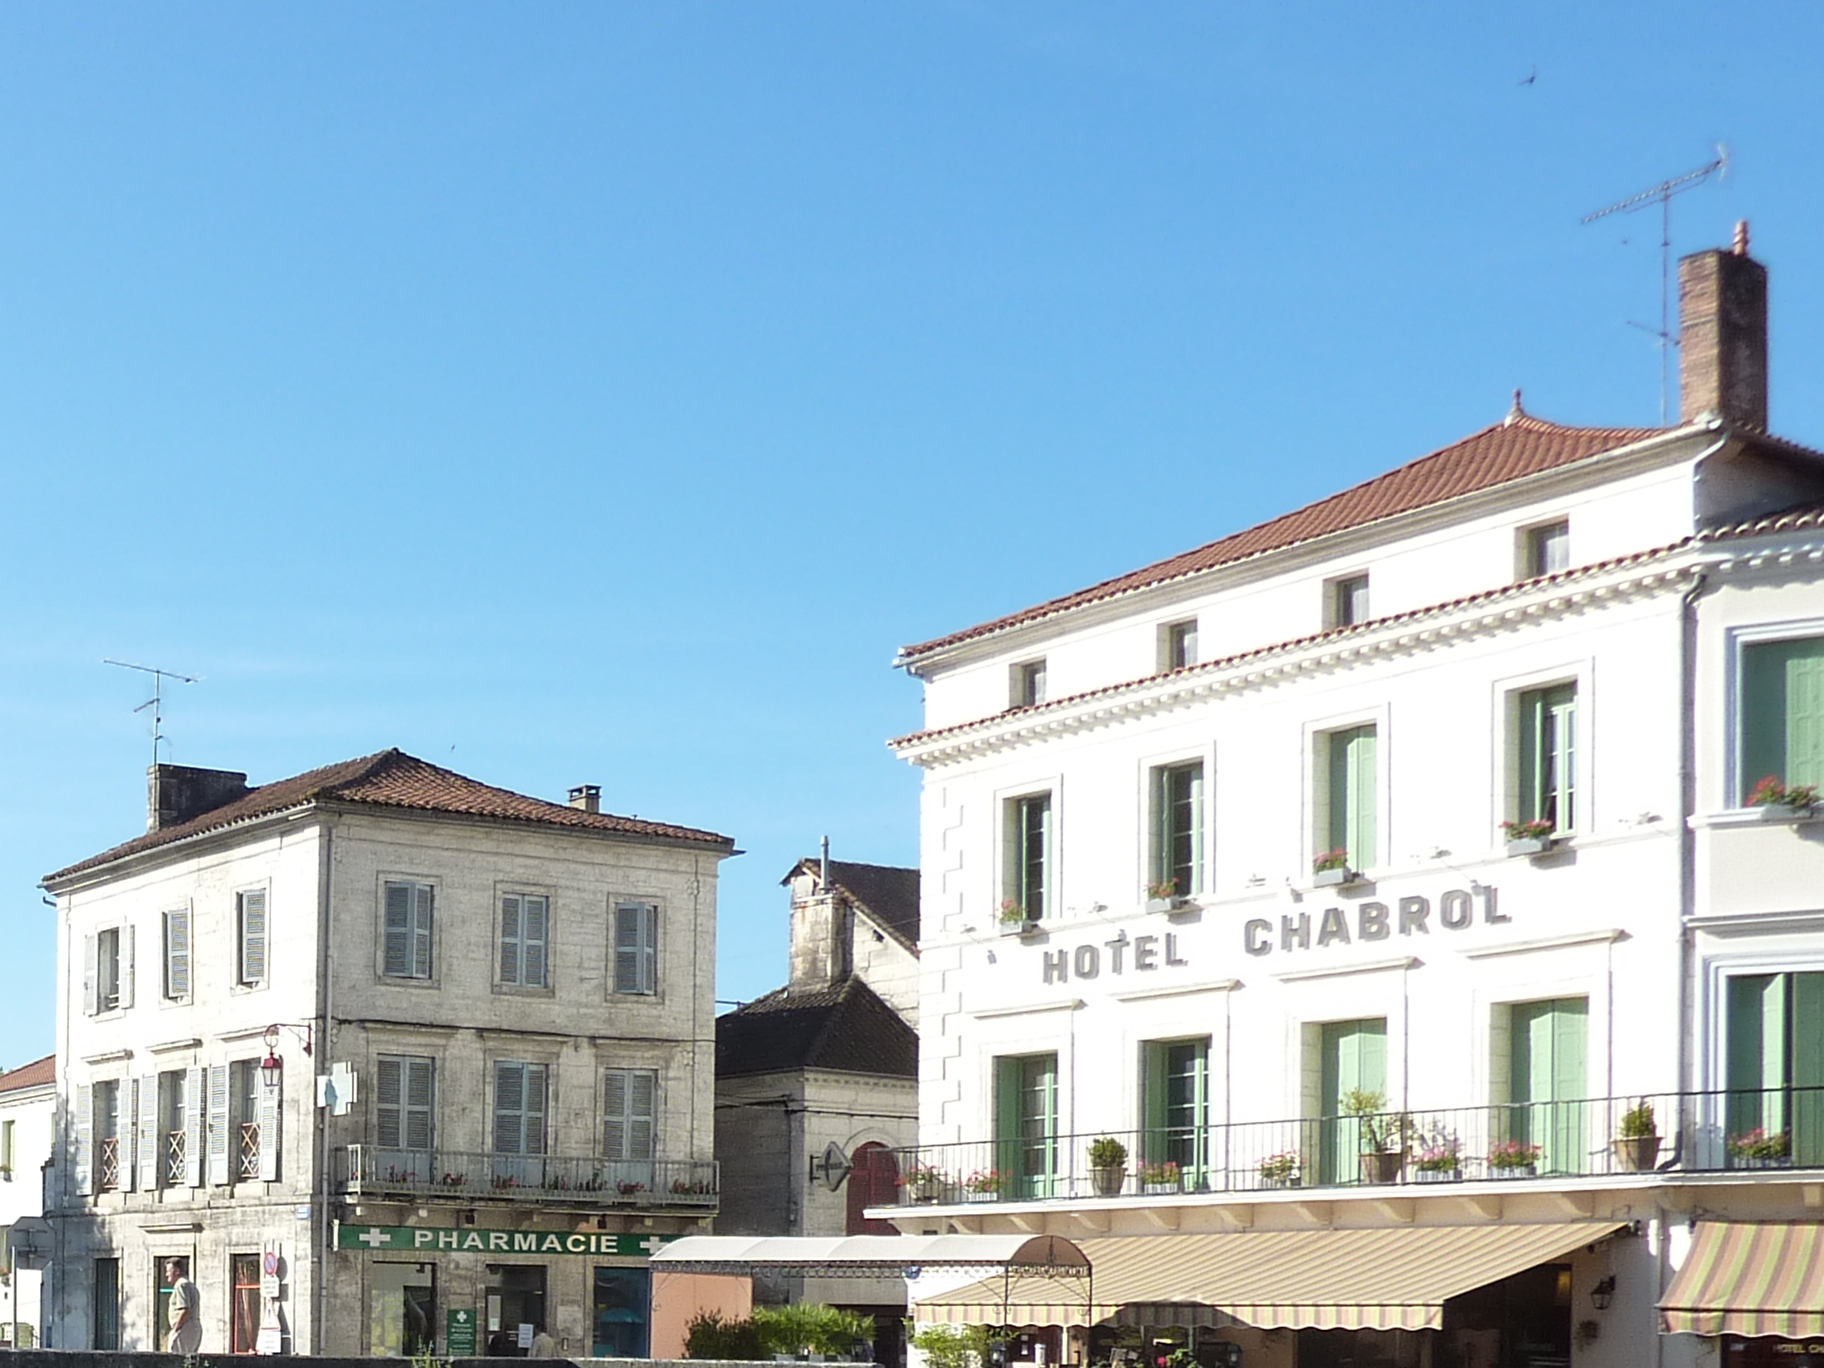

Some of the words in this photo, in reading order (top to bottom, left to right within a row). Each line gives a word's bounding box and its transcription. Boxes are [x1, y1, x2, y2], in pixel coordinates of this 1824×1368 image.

[1043, 932, 1188, 985] HOTEL
[1244, 884, 1512, 957] CHABROL
[414, 1229, 619, 1254] PHARMACIE
